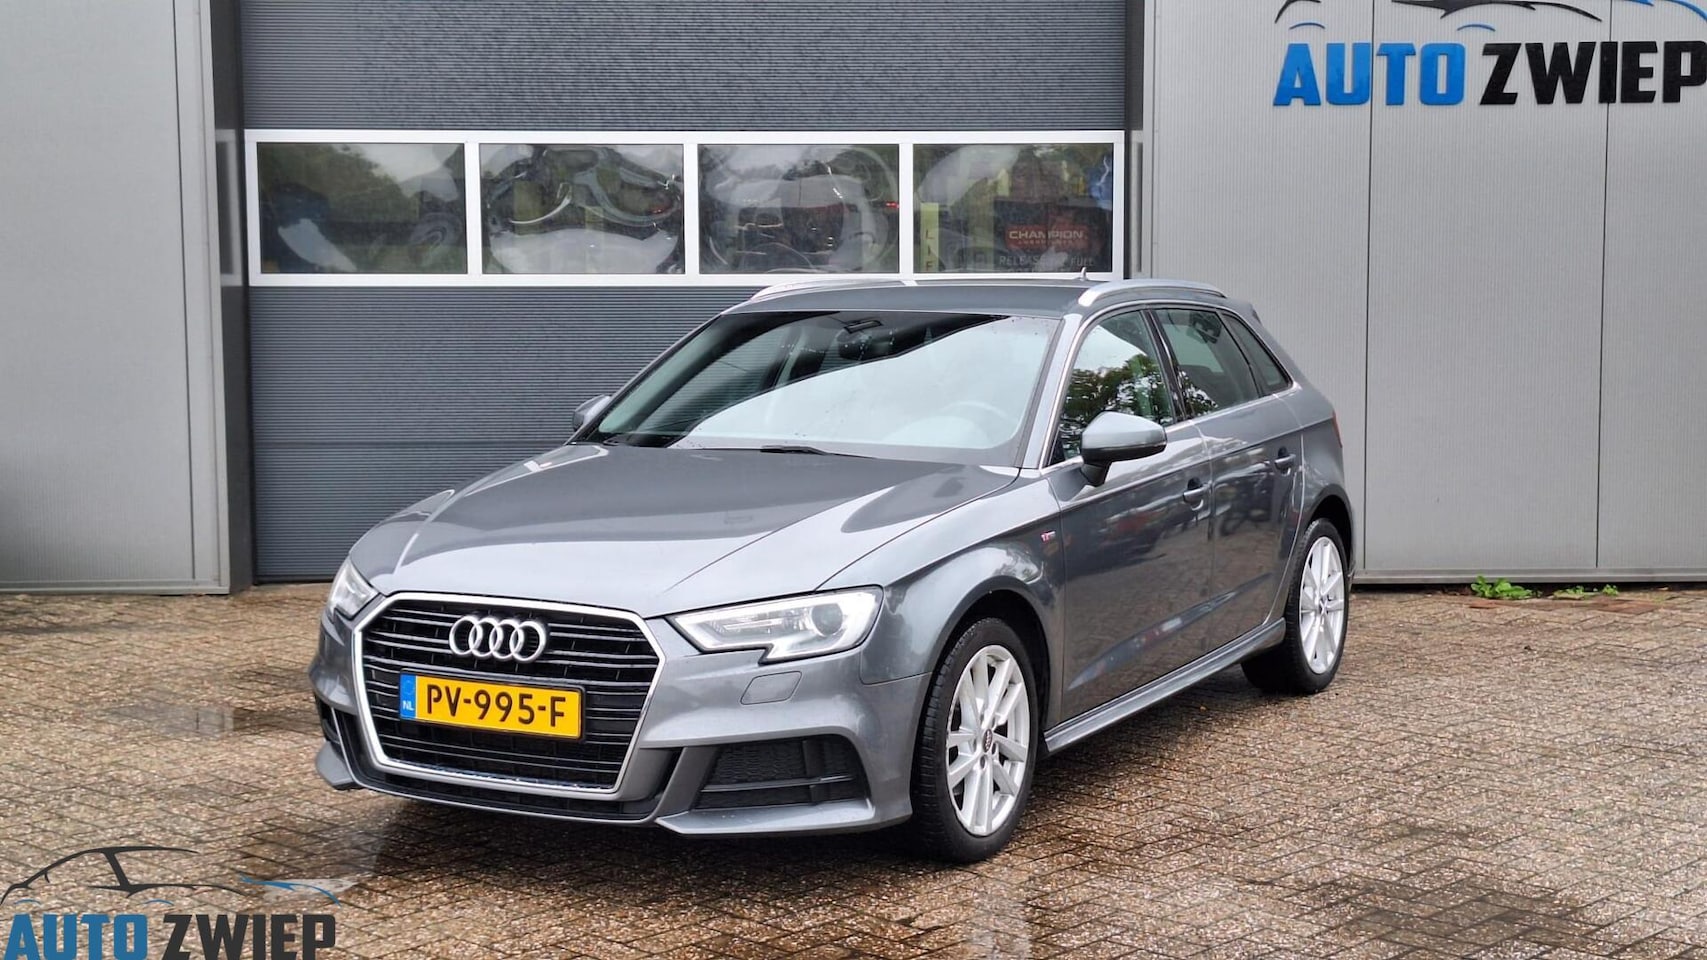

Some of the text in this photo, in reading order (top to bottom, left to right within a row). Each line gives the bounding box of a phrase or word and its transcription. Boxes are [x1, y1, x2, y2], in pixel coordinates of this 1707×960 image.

[1273, 41, 1707, 106] AUTO ZWIEP
[1008, 229, 1084, 240] CHAMPION
[402, 700, 414, 711] NL
[426, 684, 566, 727] PV-995-F
